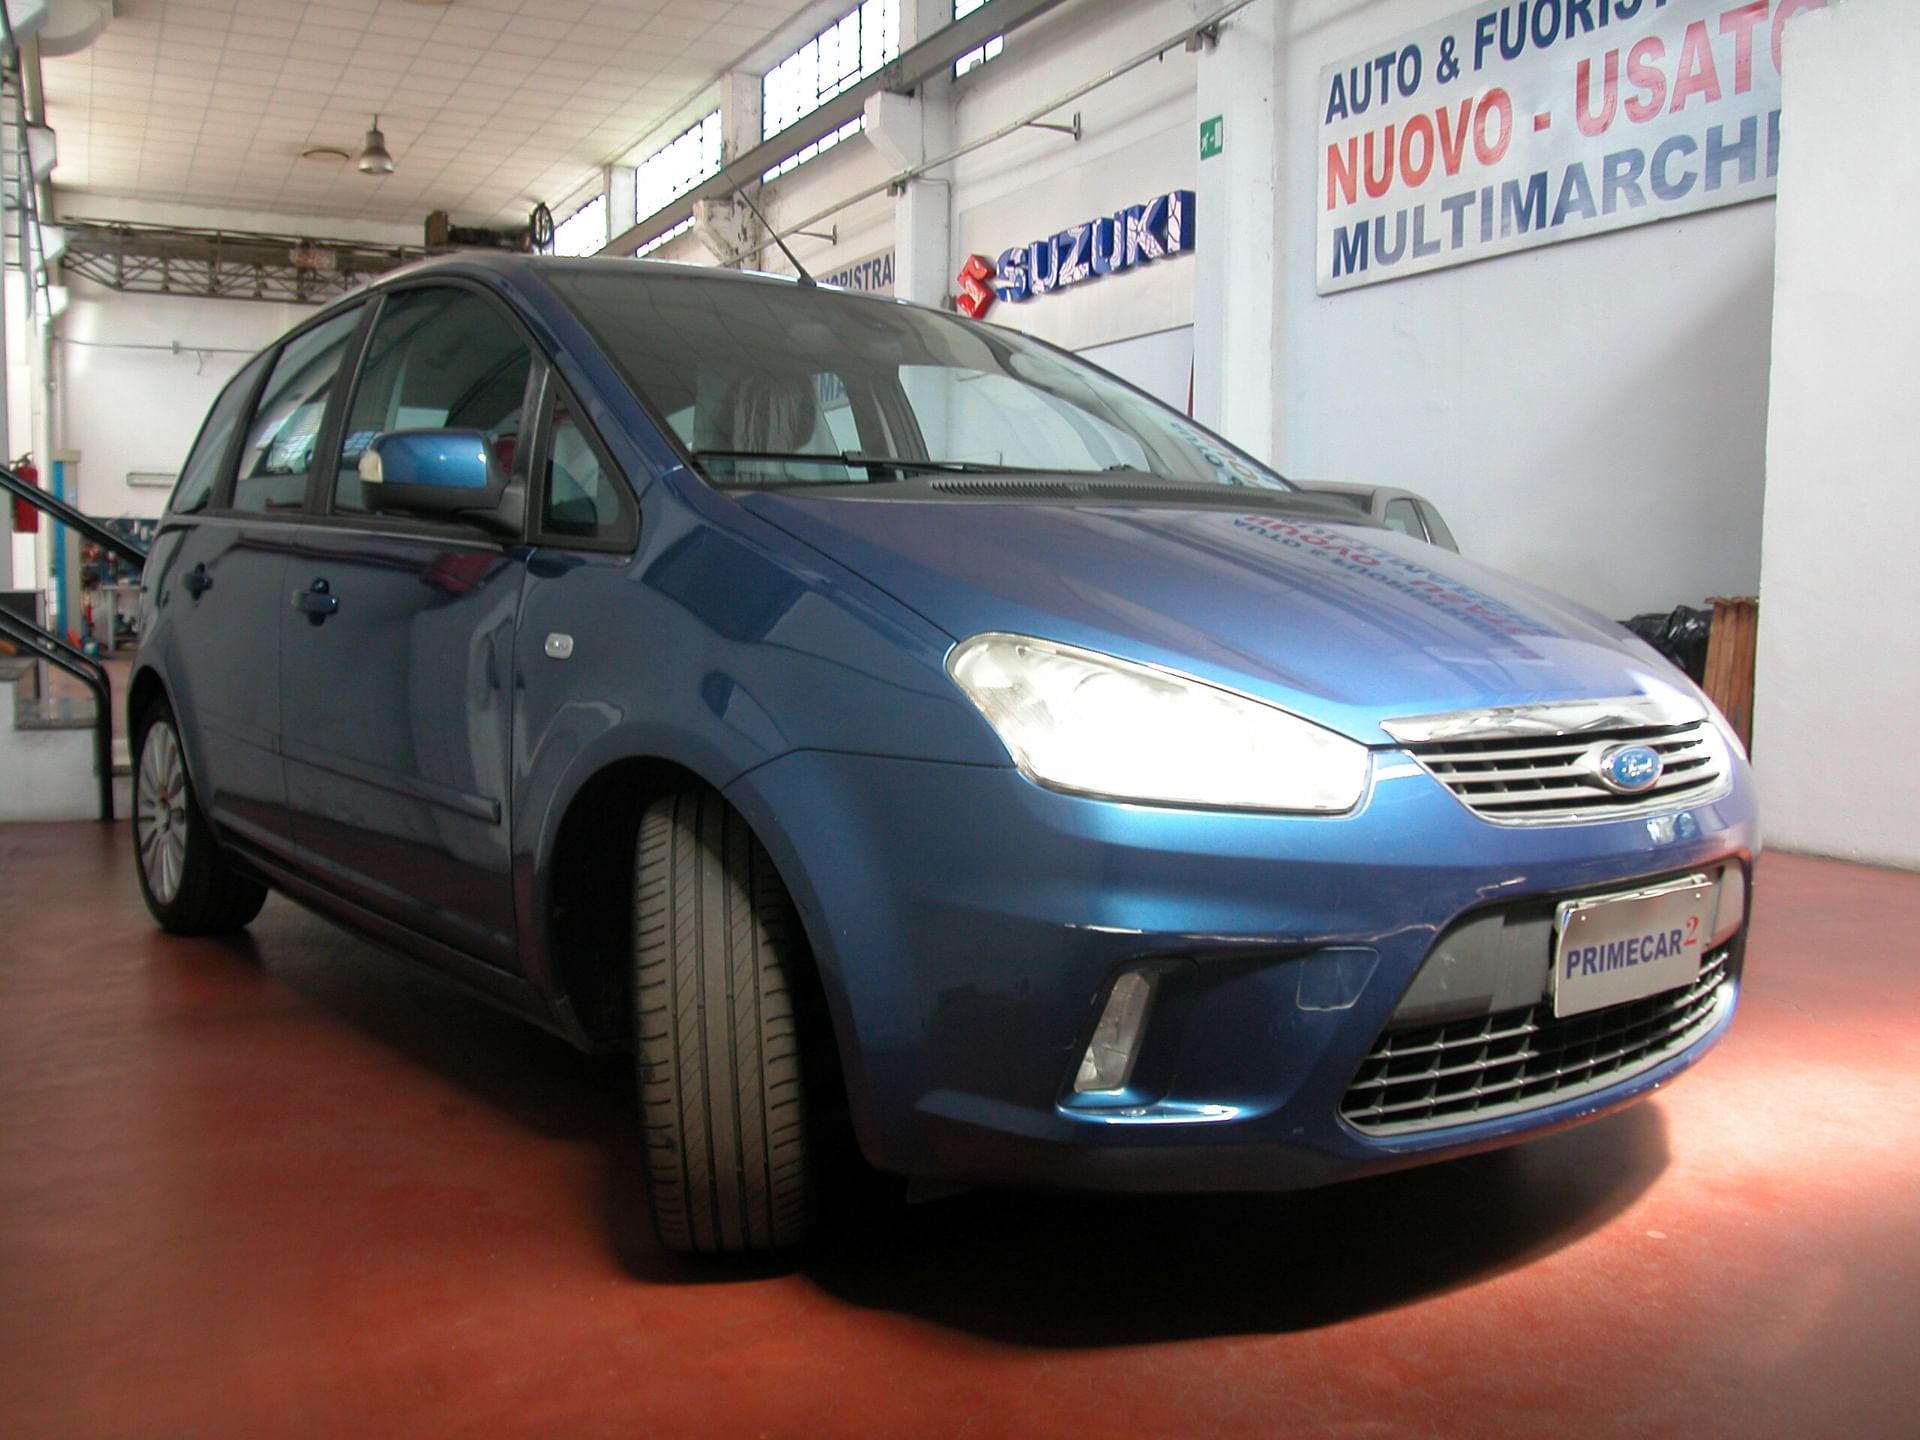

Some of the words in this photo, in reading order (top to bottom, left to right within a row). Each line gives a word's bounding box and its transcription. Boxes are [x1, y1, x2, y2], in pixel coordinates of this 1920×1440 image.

[1325, 43, 1422, 125] AUTO
[1436, 35, 1460, 84] &
[1473, 0, 1667, 72] FUOR
[1327, 87, 1513, 210] NUOVO
[818, 250, 896, 291] ORISTRA
[996, 189, 1196, 304] SUZUKI
[1566, 929, 1683, 980] PRIMECAR
